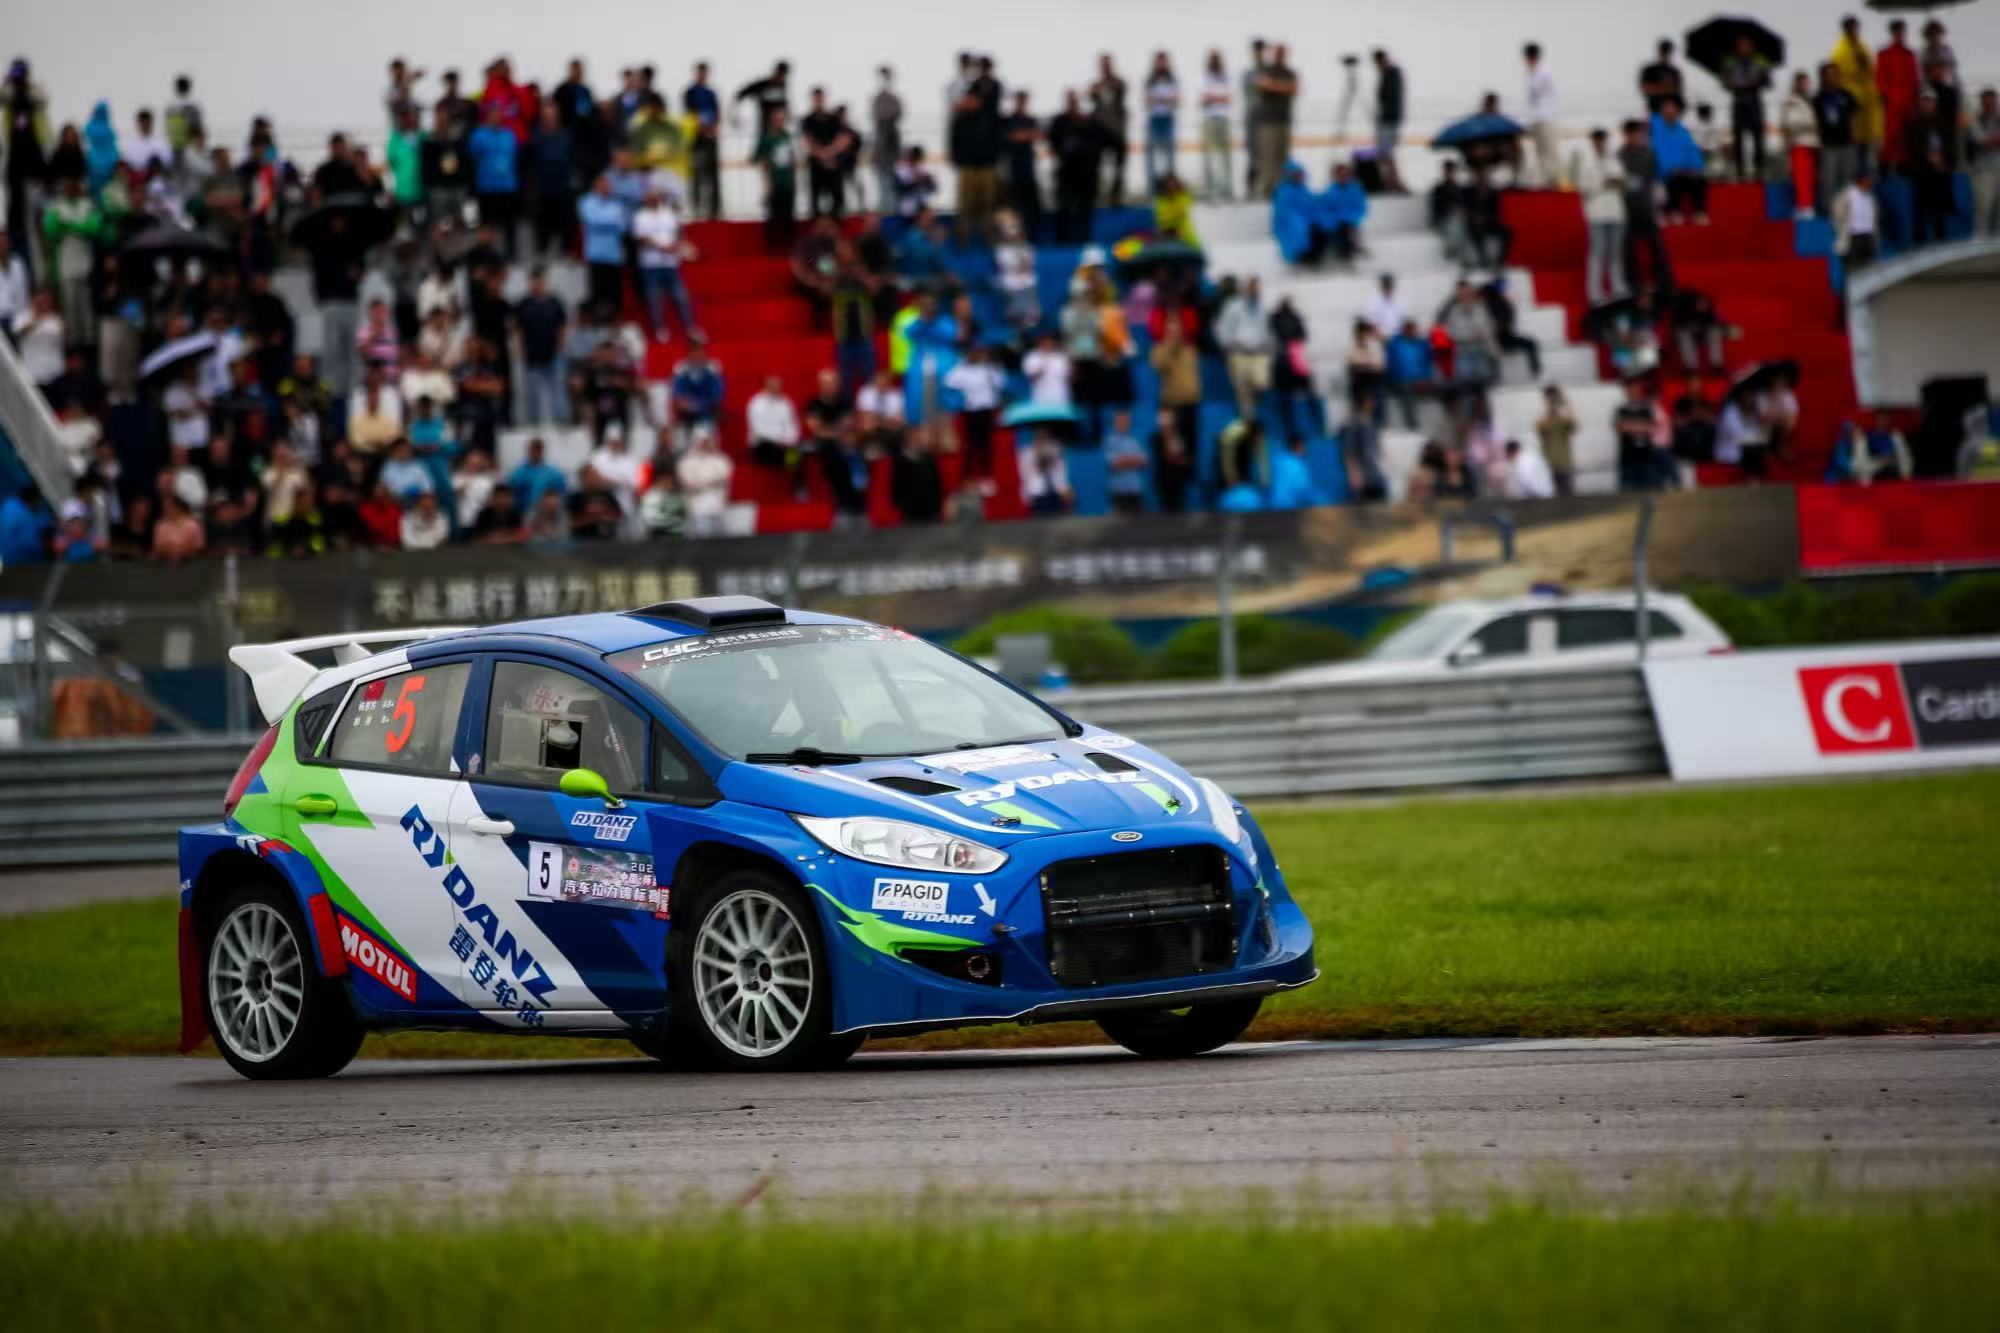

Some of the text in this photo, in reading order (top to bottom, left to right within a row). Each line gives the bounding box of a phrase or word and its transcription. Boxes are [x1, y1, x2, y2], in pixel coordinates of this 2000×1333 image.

[385, 674, 426, 753] 5
[1823, 673, 1892, 743] C
[573, 813, 636, 828] RYDANZ
[540, 851, 551, 889] 5
[893, 884, 943, 900] PAGID
[400, 804, 558, 1008] RYDANZ
[902, 911, 977, 924] RYDANZ
[341, 925, 411, 995] MOTUL
[449, 923, 545, 1027] 雷登轮胎
